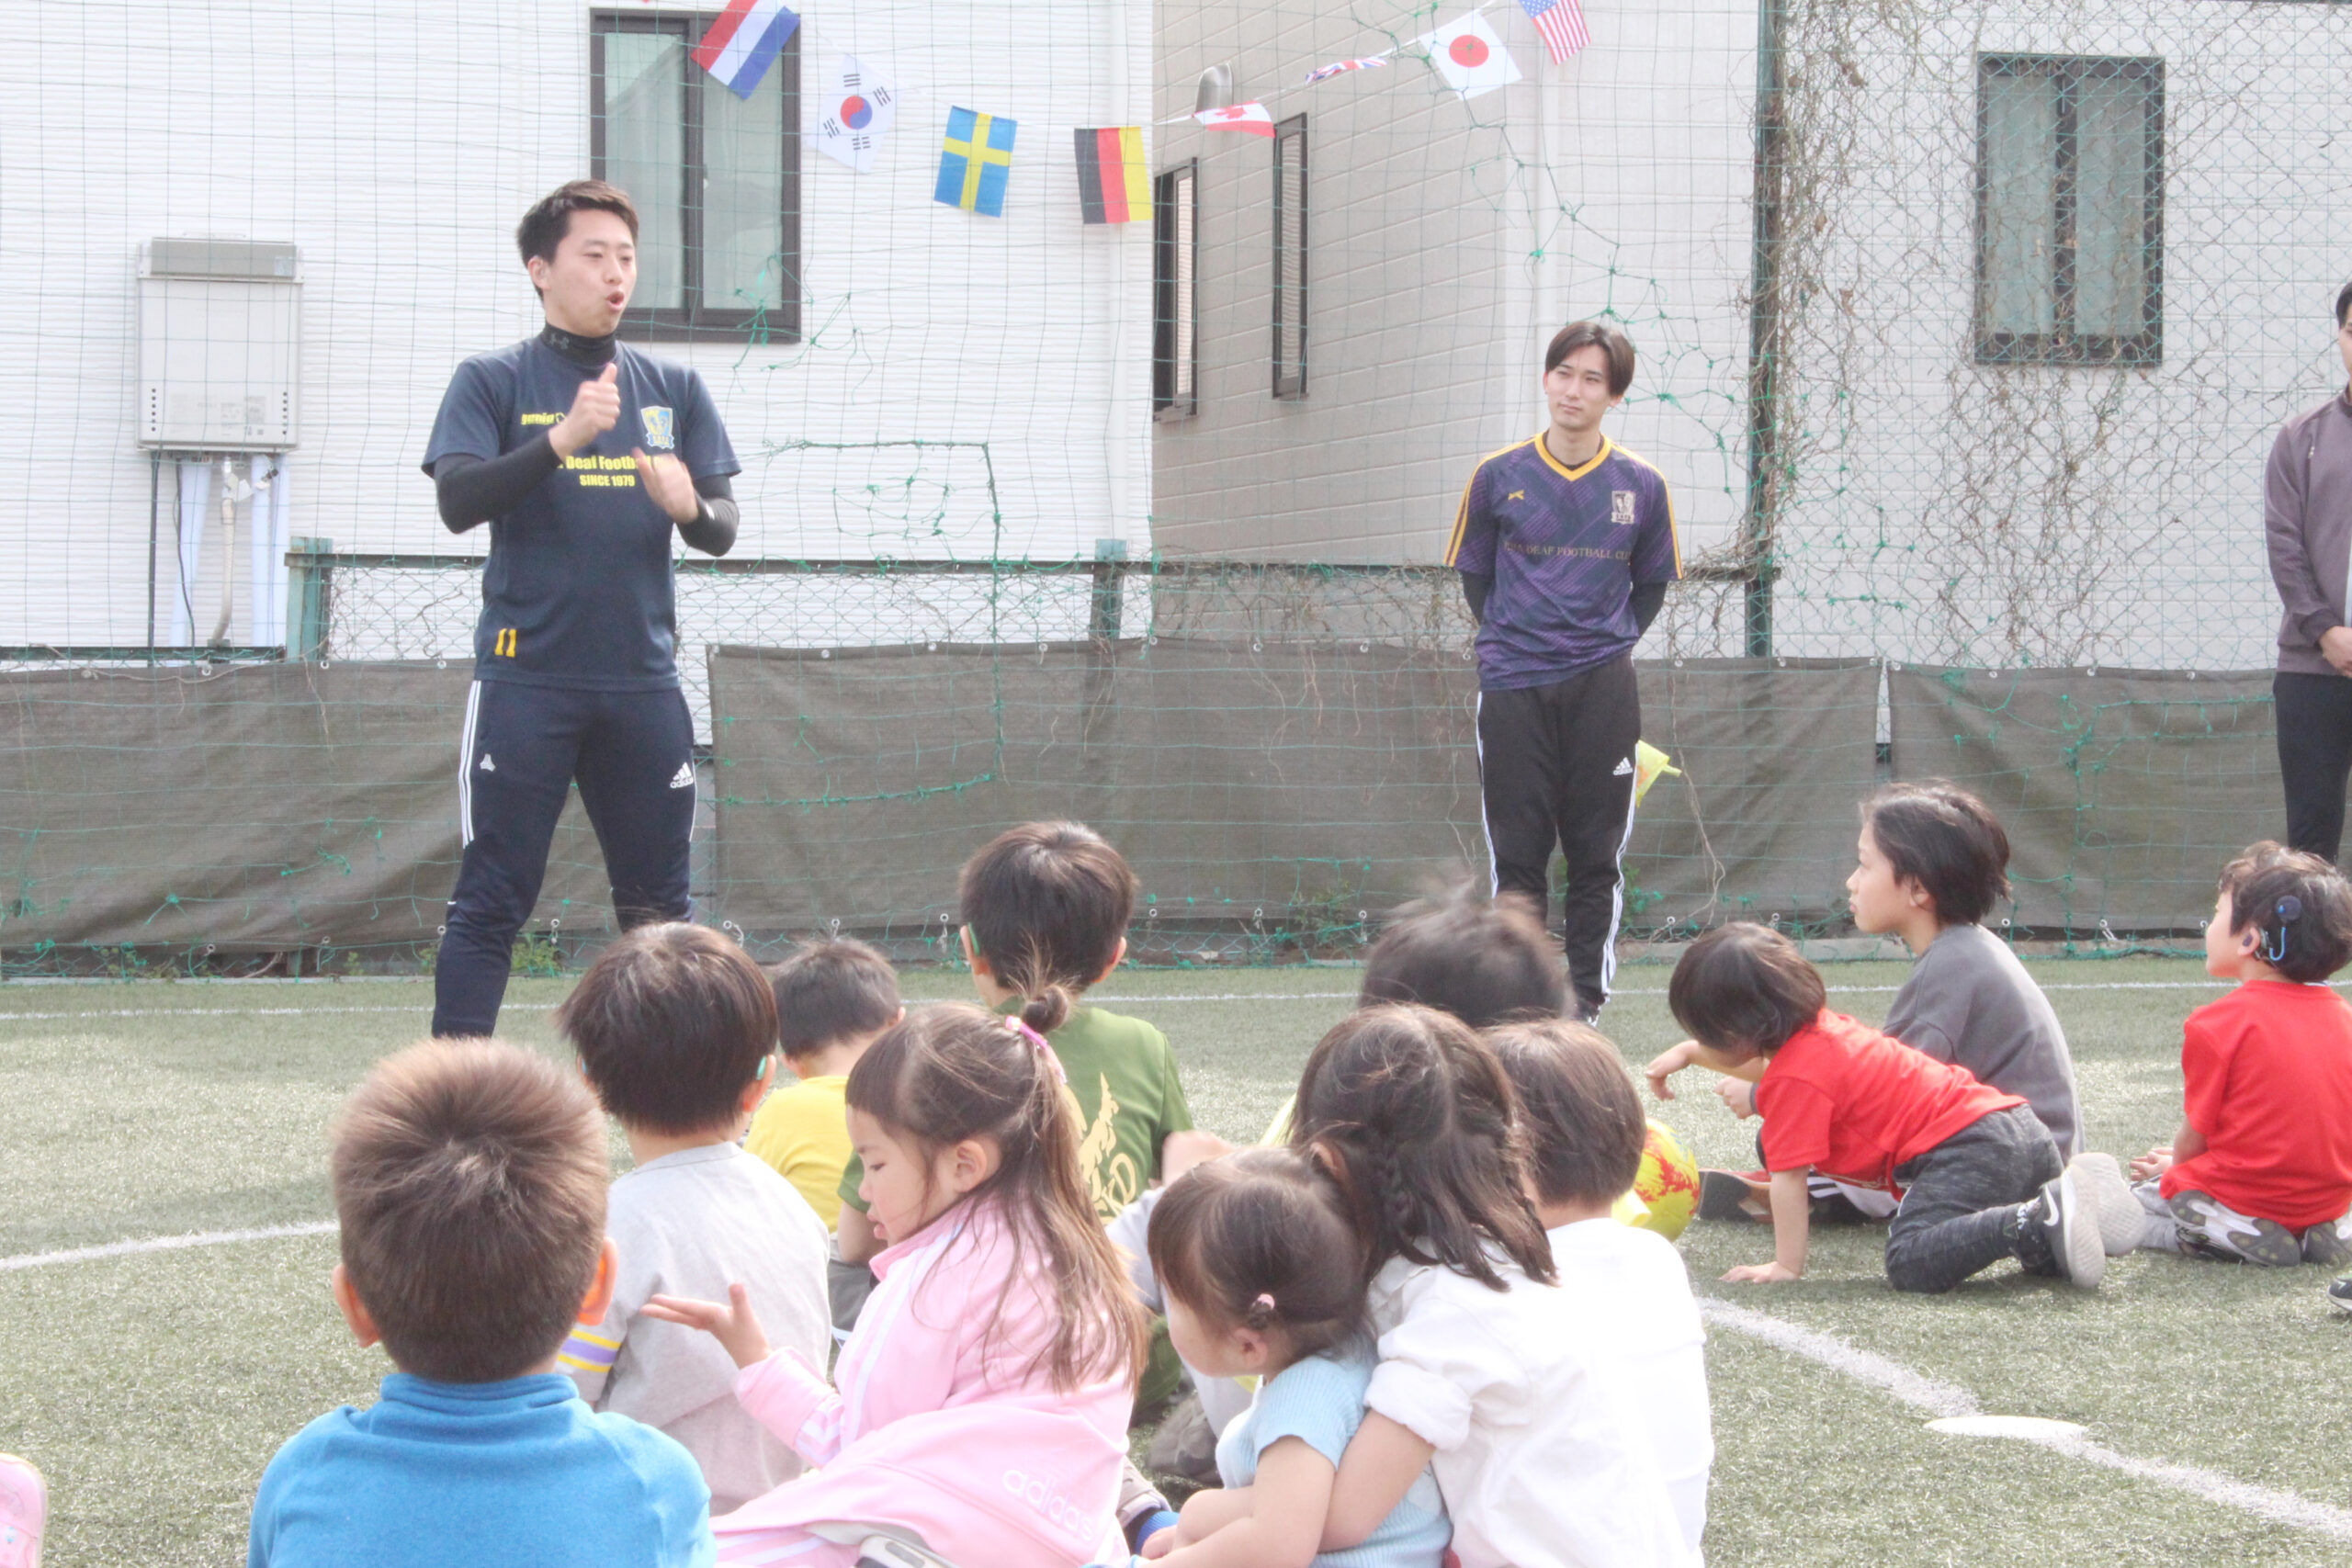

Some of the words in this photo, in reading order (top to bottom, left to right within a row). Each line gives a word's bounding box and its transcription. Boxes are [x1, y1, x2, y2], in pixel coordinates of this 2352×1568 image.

[579, 475, 610, 487] SINCE
[610, 475, 636, 487] 1979
[1556, 546, 1613, 559] FOOTBALL
[494, 627, 516, 658] 11
[1002, 1470, 1093, 1541] adidas
